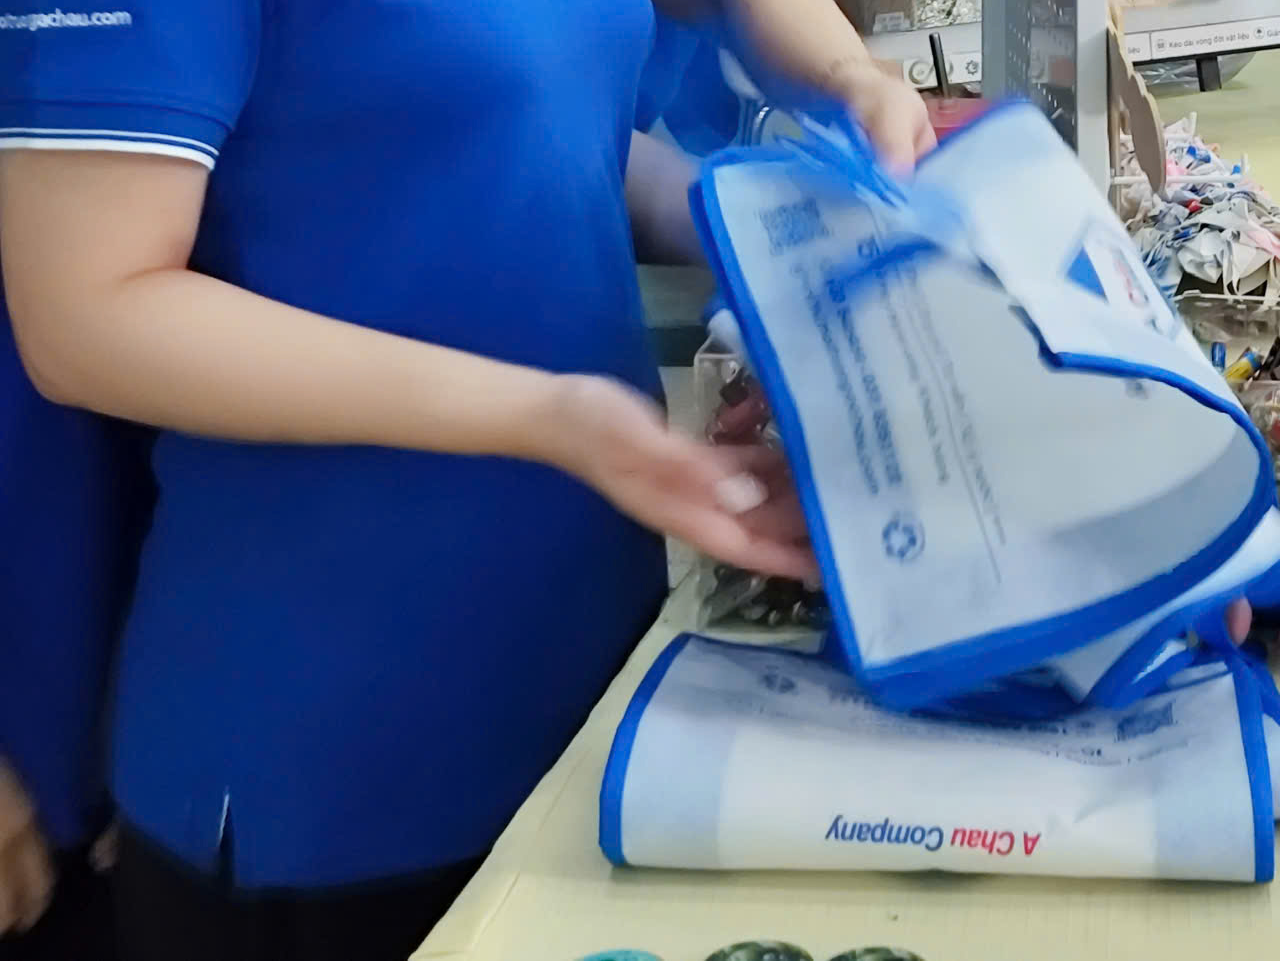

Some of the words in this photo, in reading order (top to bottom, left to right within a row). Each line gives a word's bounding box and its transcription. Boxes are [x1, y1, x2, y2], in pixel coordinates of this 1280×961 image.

[825, 814, 944, 852] Company
[950, 827, 1015, 856] Chau
[1023, 831, 1041, 856] A
